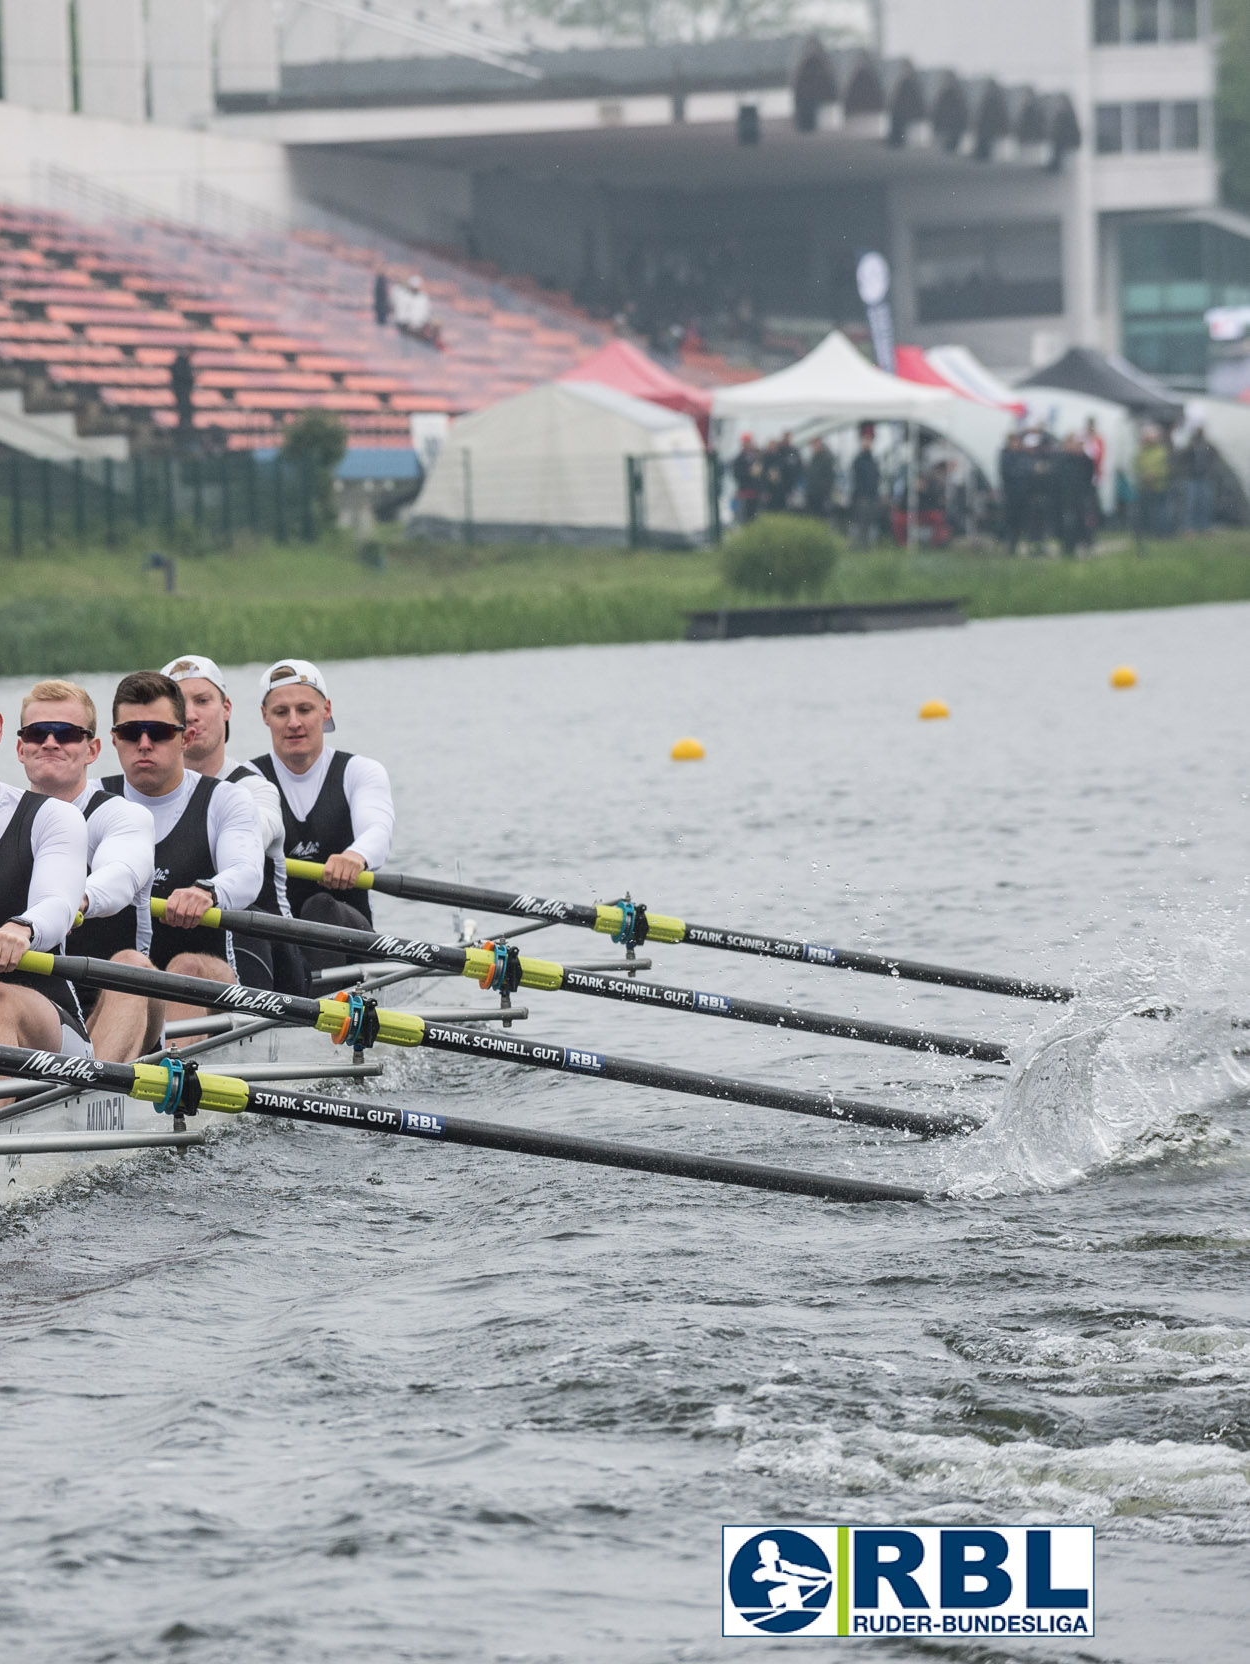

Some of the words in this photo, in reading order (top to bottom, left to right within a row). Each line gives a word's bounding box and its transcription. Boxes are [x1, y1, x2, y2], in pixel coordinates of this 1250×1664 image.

[689, 929, 725, 944] STARK.
[726, 935, 774, 953] SCHNELL.
[807, 947, 836, 962] RBL
[567, 973, 606, 990] STARK.
[608, 980, 661, 1000] SCHNELL.
[663, 990, 692, 1006] GUT.
[698, 994, 729, 1010] RBL
[429, 1028, 470, 1046] STARK.
[472, 1036, 530, 1056] SCHNELL.
[532, 1047, 560, 1062] GUT.
[569, 1051, 602, 1068] RBL
[254, 1092, 300, 1111] STARK.
[302, 1099, 365, 1120] SCHNELL.
[367, 1109, 397, 1126] GUT.
[407, 1113, 442, 1130] RBL
